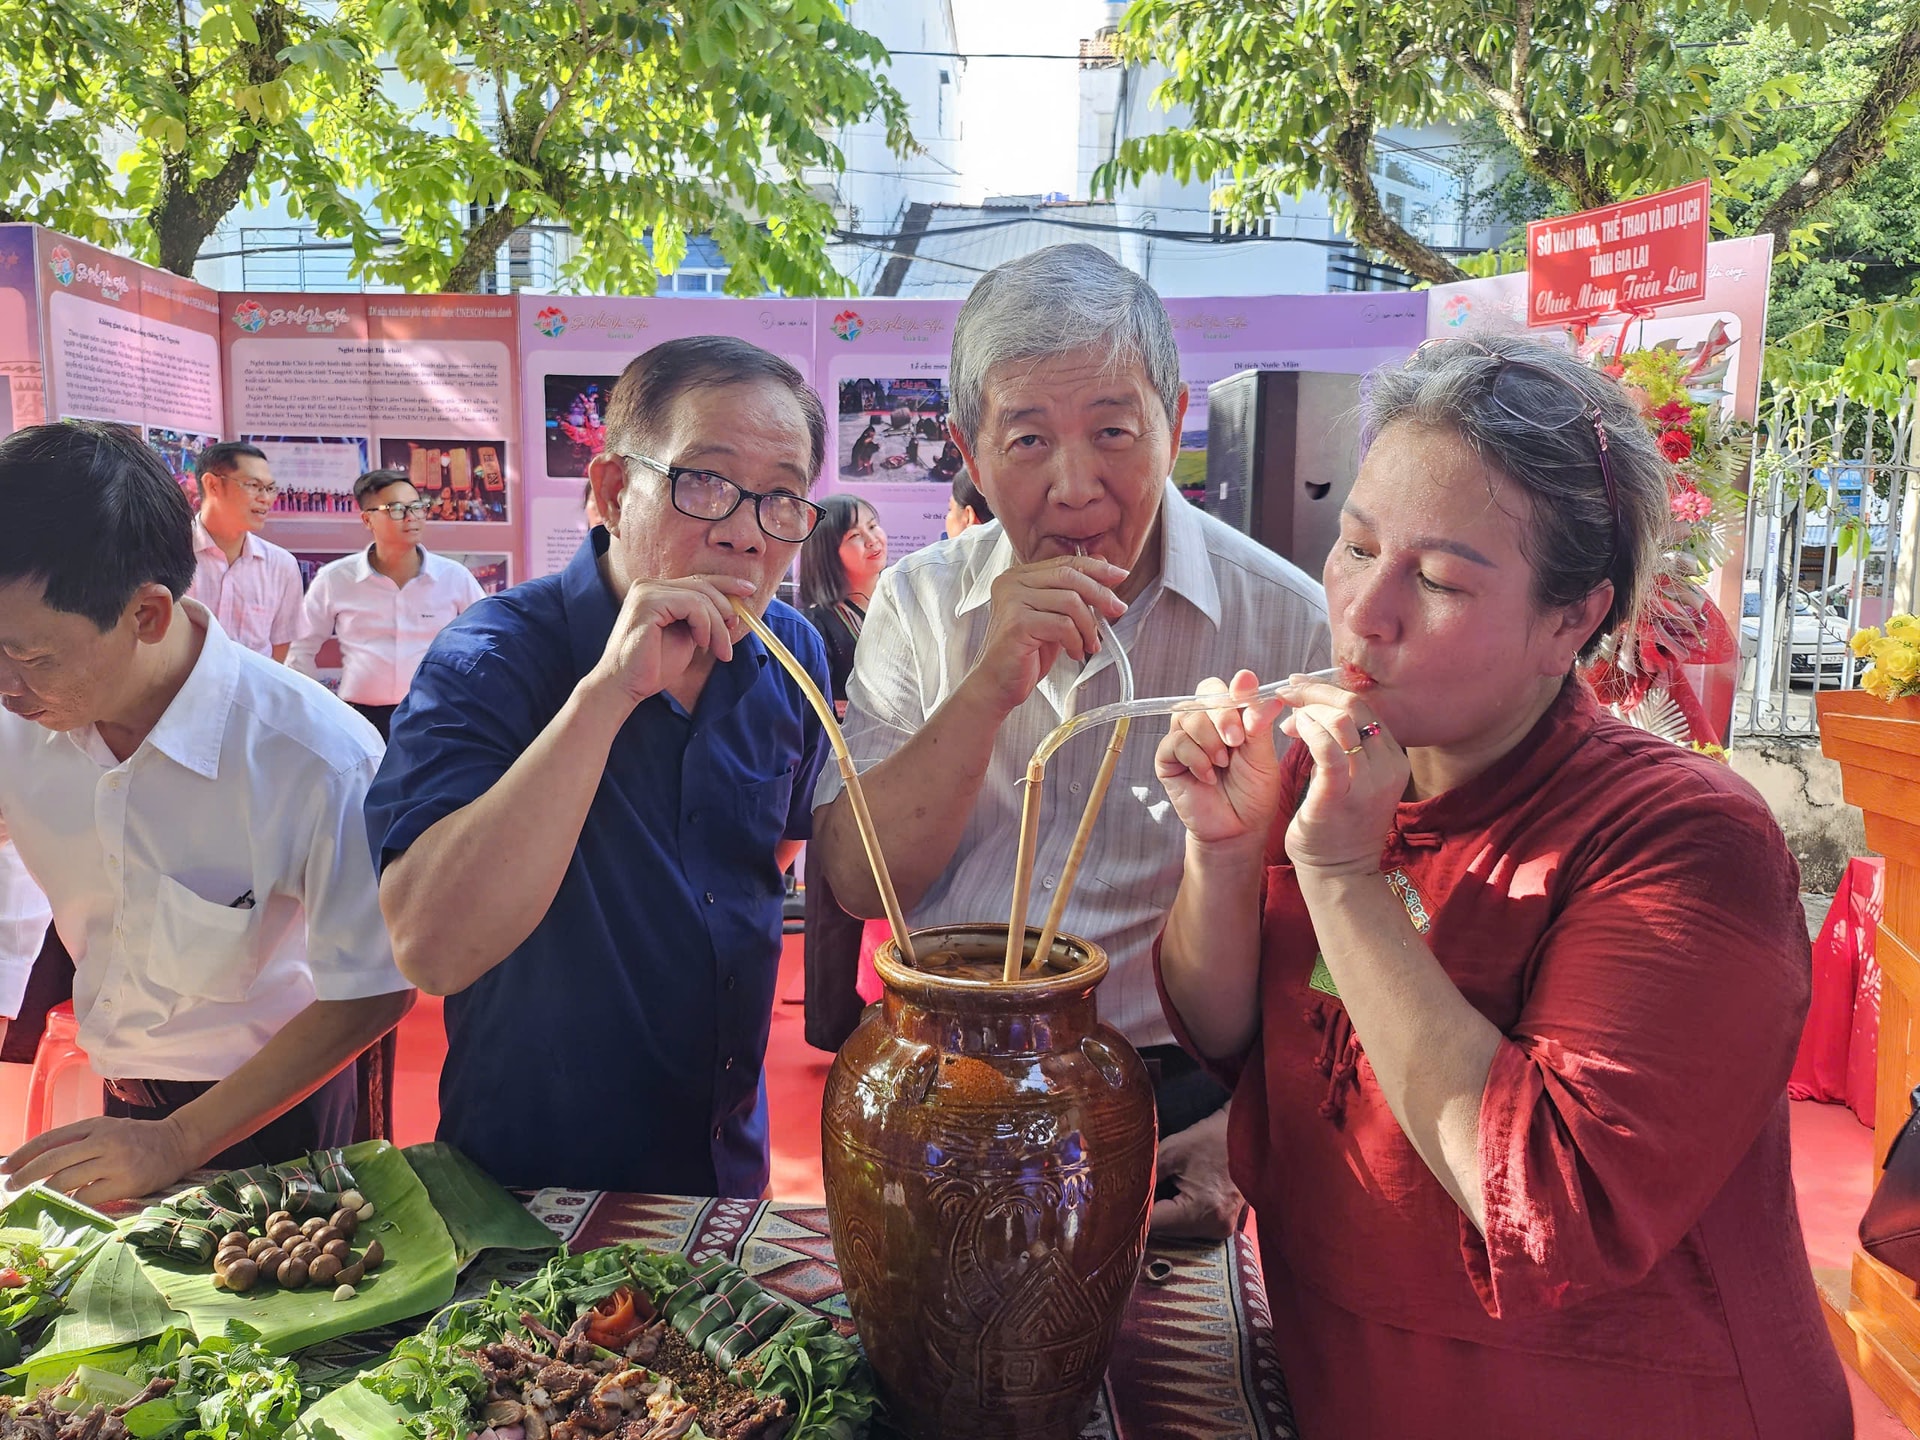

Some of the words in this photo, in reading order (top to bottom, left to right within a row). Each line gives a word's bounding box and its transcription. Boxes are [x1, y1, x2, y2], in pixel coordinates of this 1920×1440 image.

[1537, 227, 1552, 257] SỞ
[1553, 227, 1574, 254] VĂN
[1576, 222, 1600, 251] HÓA,
[1601, 210, 1620, 244] THỂ
[1621, 211, 1647, 239] THAO
[1649, 204, 1662, 233] VÀ
[1663, 205, 1678, 228] DU
[1680, 198, 1700, 230] LỊCH
[1589, 246, 1613, 278] TỈNH
[1615, 249, 1632, 273] GIA
[1633, 245, 1649, 270] LAI
[1536, 290, 1571, 316] Chúc
[1574, 284, 1617, 311] Mừng
[1622, 270, 1660, 302] Triển
[1664, 266, 1698, 295] Lãm
